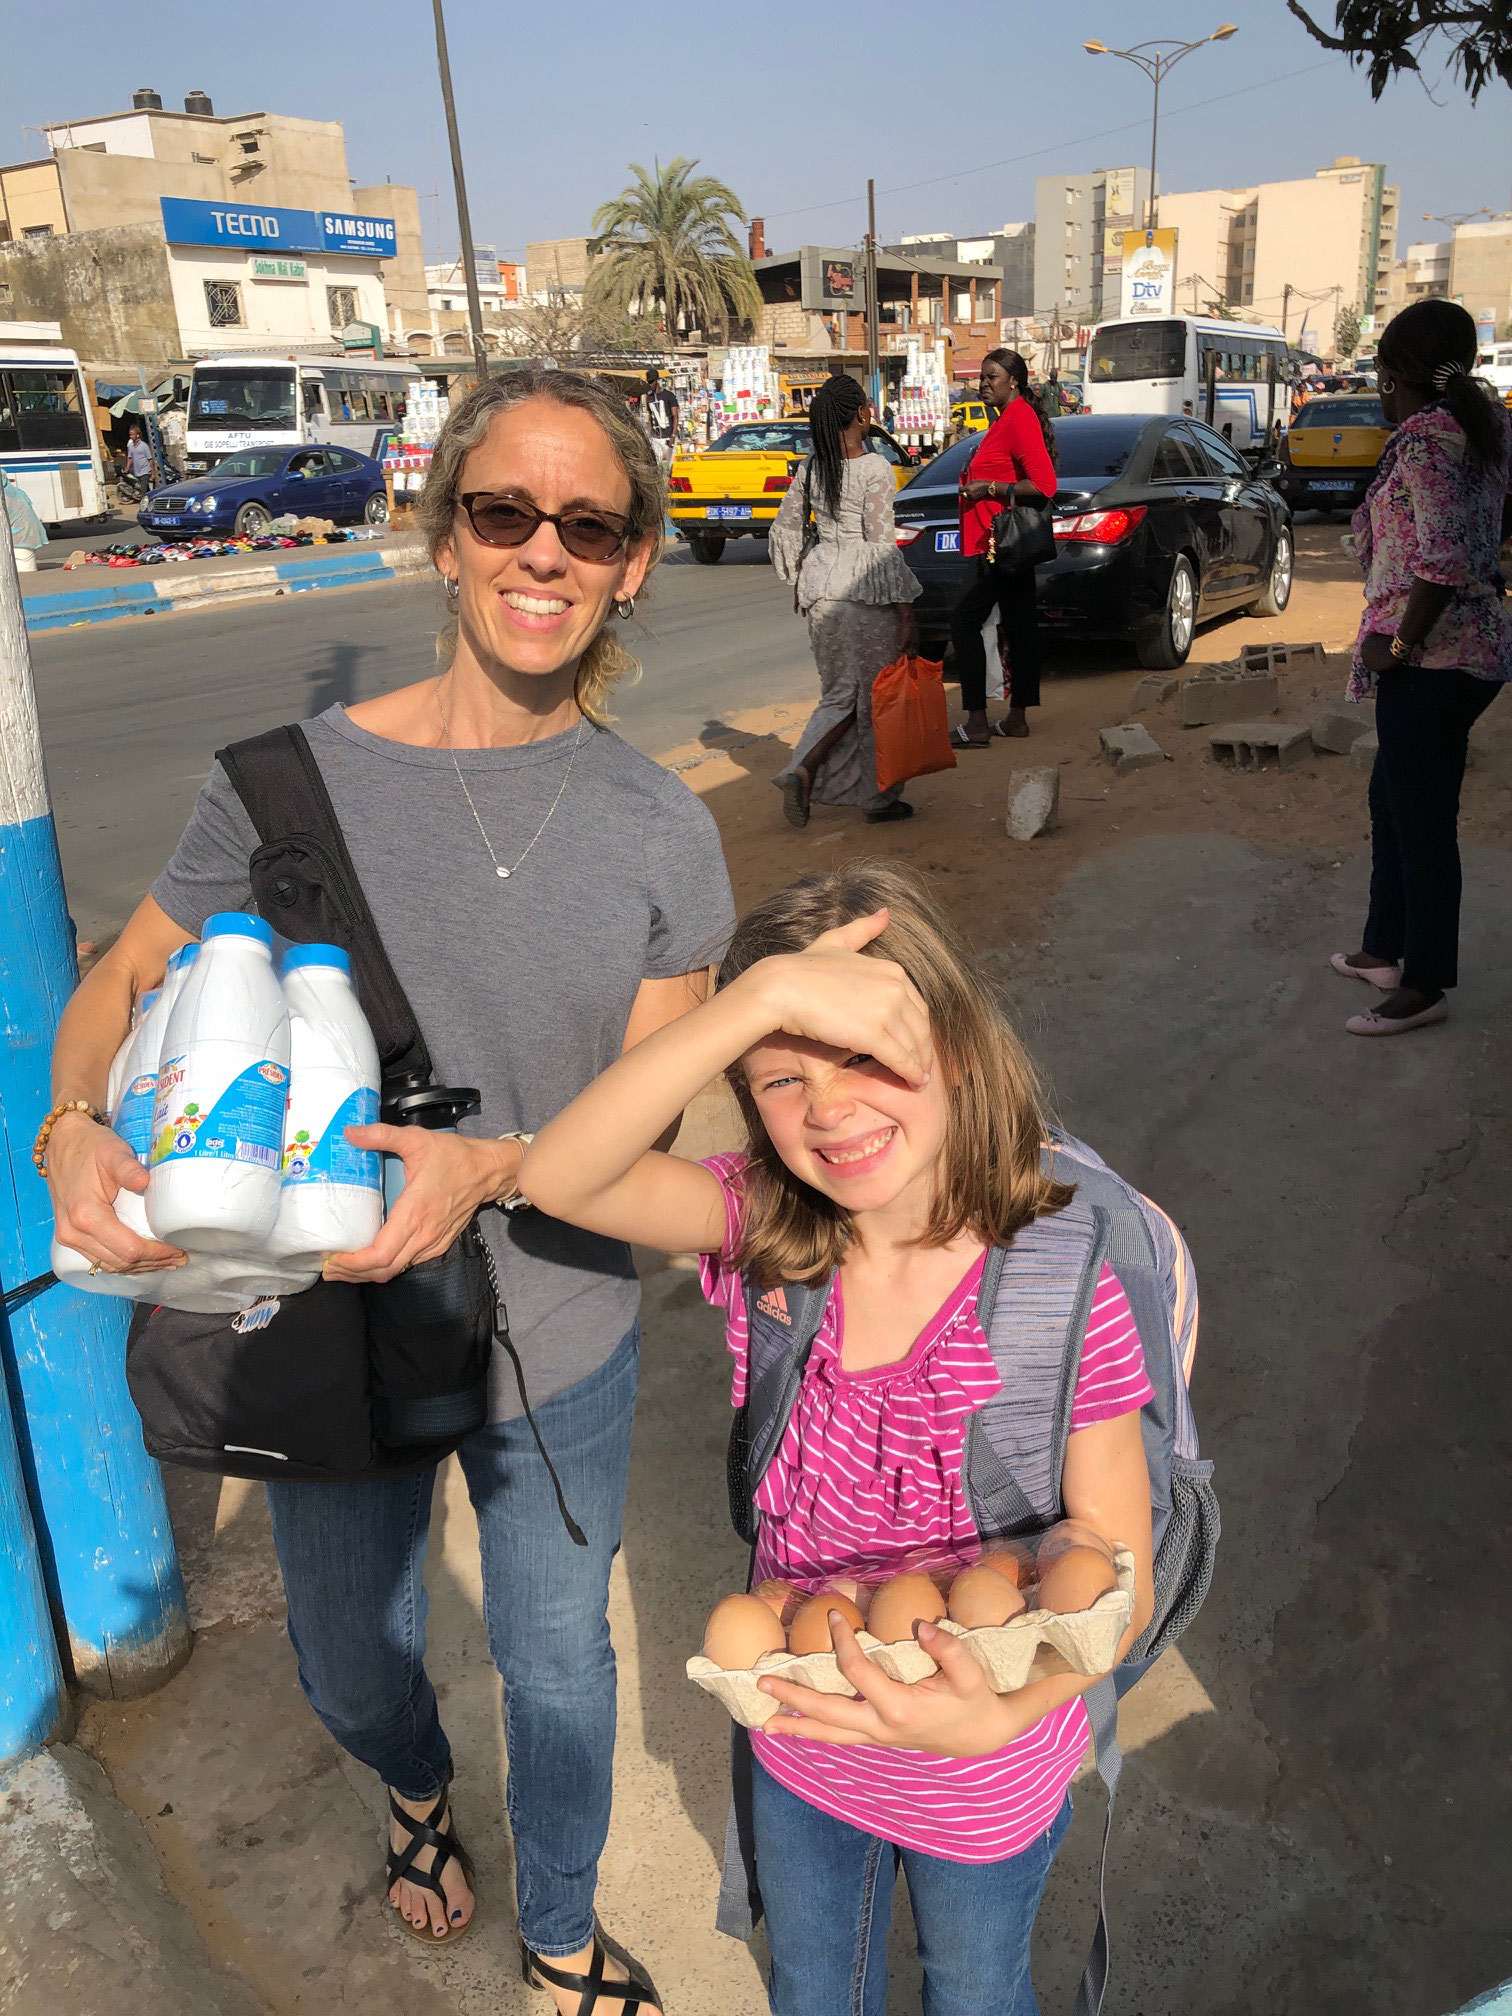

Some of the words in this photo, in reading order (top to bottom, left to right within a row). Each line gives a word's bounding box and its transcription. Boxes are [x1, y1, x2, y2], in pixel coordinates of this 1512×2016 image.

[210, 211, 280, 238] TECNO
[324, 217, 394, 240] SAMSUNG
[201, 400, 210, 414] 5
[756, 1300, 792, 1326] adidas
